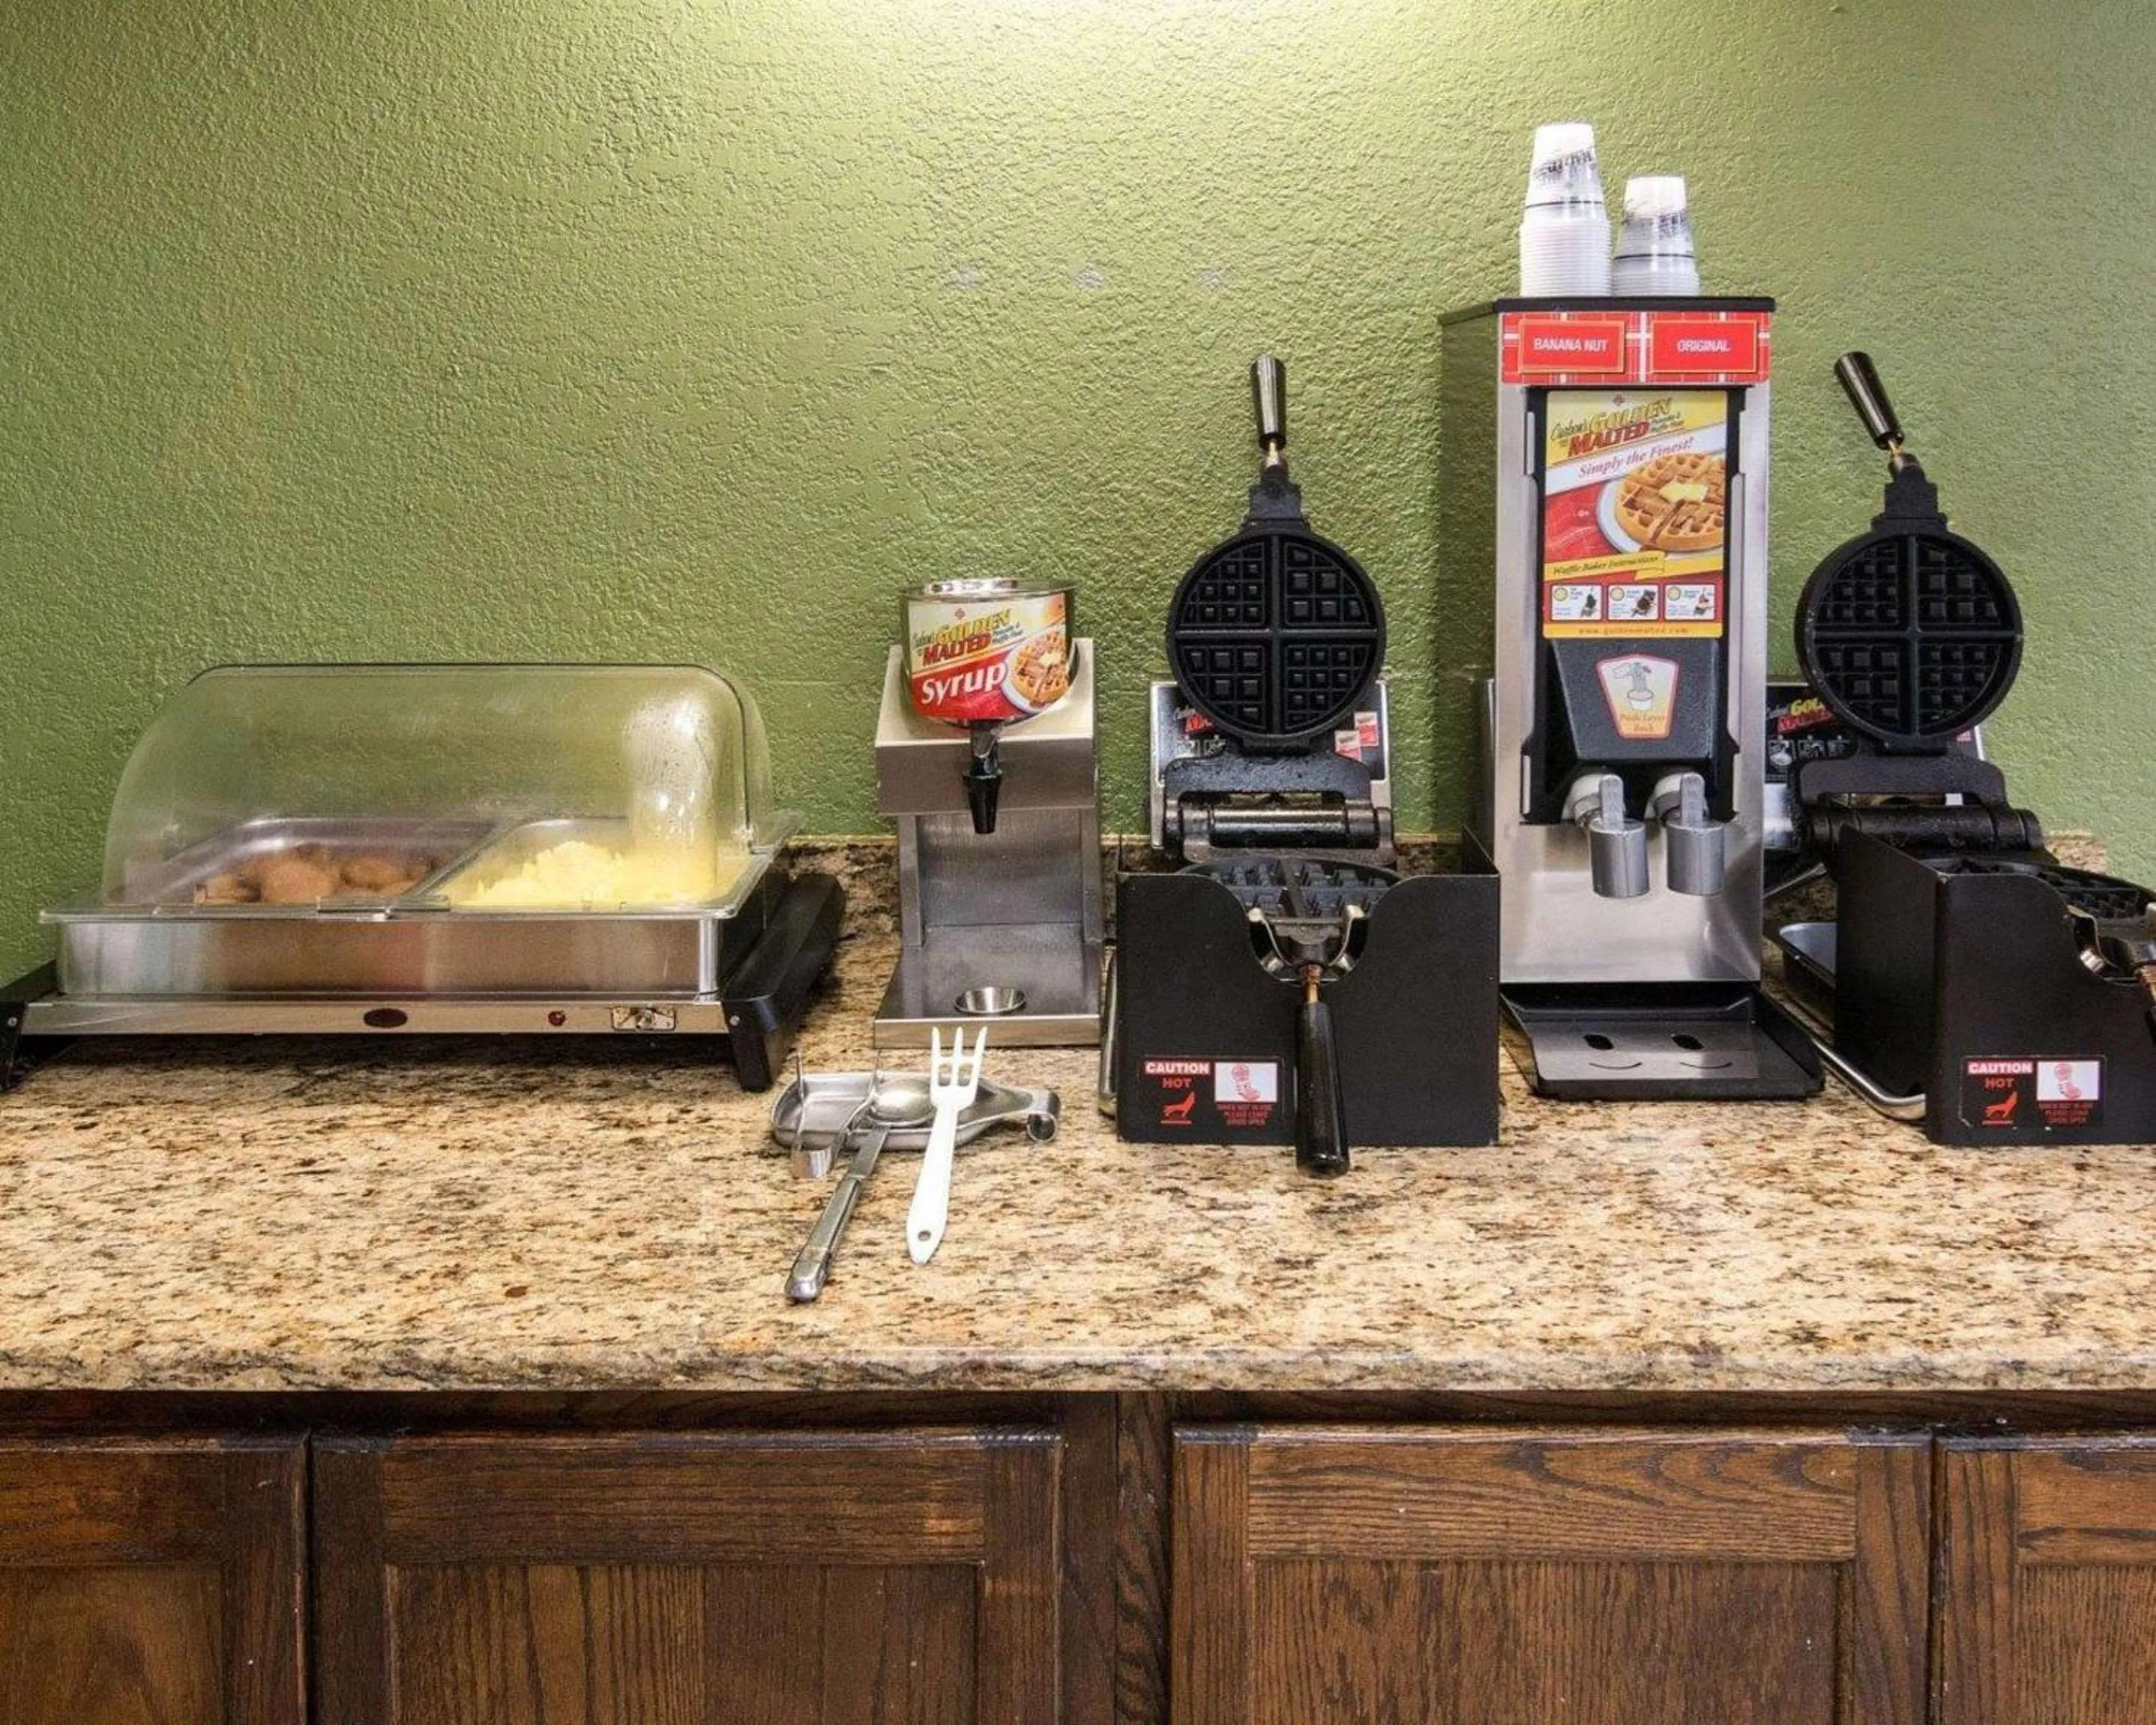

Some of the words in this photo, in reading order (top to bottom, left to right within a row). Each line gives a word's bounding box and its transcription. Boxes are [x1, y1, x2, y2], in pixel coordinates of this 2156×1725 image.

[1533, 338, 1582, 352] BANANA
[1584, 338, 1609, 353] NUT
[1676, 339, 1732, 353] ORIGINAL
[1568, 421, 1651, 457] MALTED
[1579, 457, 1624, 478] Simply
[1627, 451, 1647, 465] the
[1650, 436, 1694, 458] Finest!
[1553, 564, 1580, 575] Waffle
[1583, 561, 1607, 571] Baker
[937, 609, 1011, 643] GOLDEN
[923, 632, 992, 666] MALTED
[921, 661, 1007, 705] Syrup
[1145, 1062, 1211, 1074] CAUTION
[1967, 1062, 2034, 1074] CAUTION
[1162, 1077, 1193, 1089] HOT
[1984, 1077, 2015, 1089] HOT
